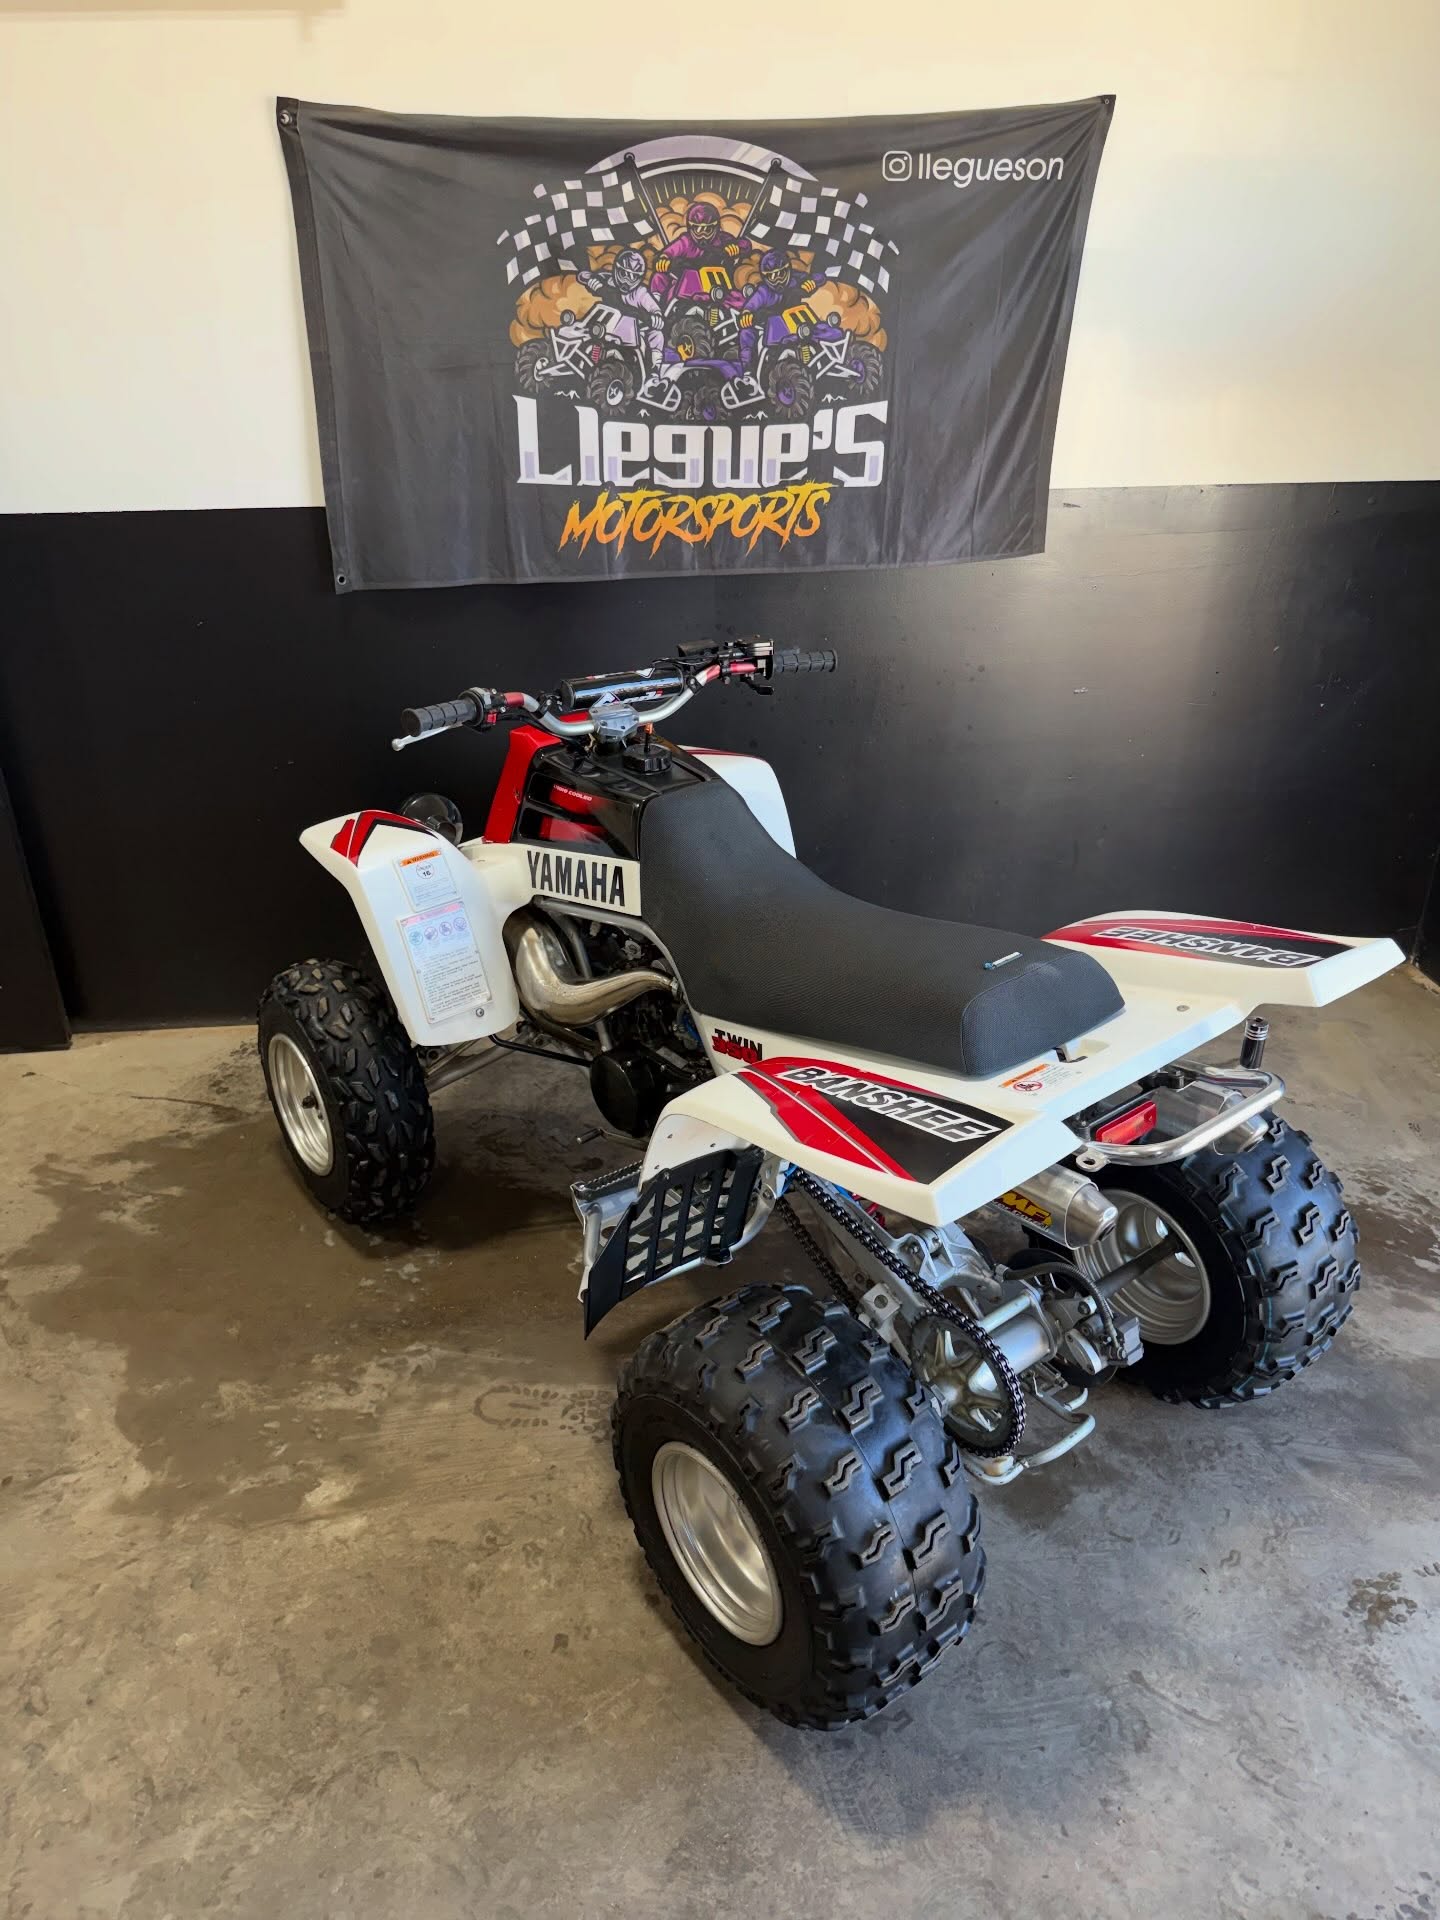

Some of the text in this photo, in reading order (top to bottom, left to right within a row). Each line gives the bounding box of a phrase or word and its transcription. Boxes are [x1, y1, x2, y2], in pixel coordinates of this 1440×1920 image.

[918, 153, 1064, 188] llegueson
[558, 479, 838, 560] MOTORSPORTS
[568, 790, 592, 801] COOLED
[527, 850, 625, 907] YAMAHA
[1091, 926, 1325, 966] BANSHEE
[714, 1028, 762, 1062] TWIN
[774, 1066, 1002, 1142] BANSHEE
